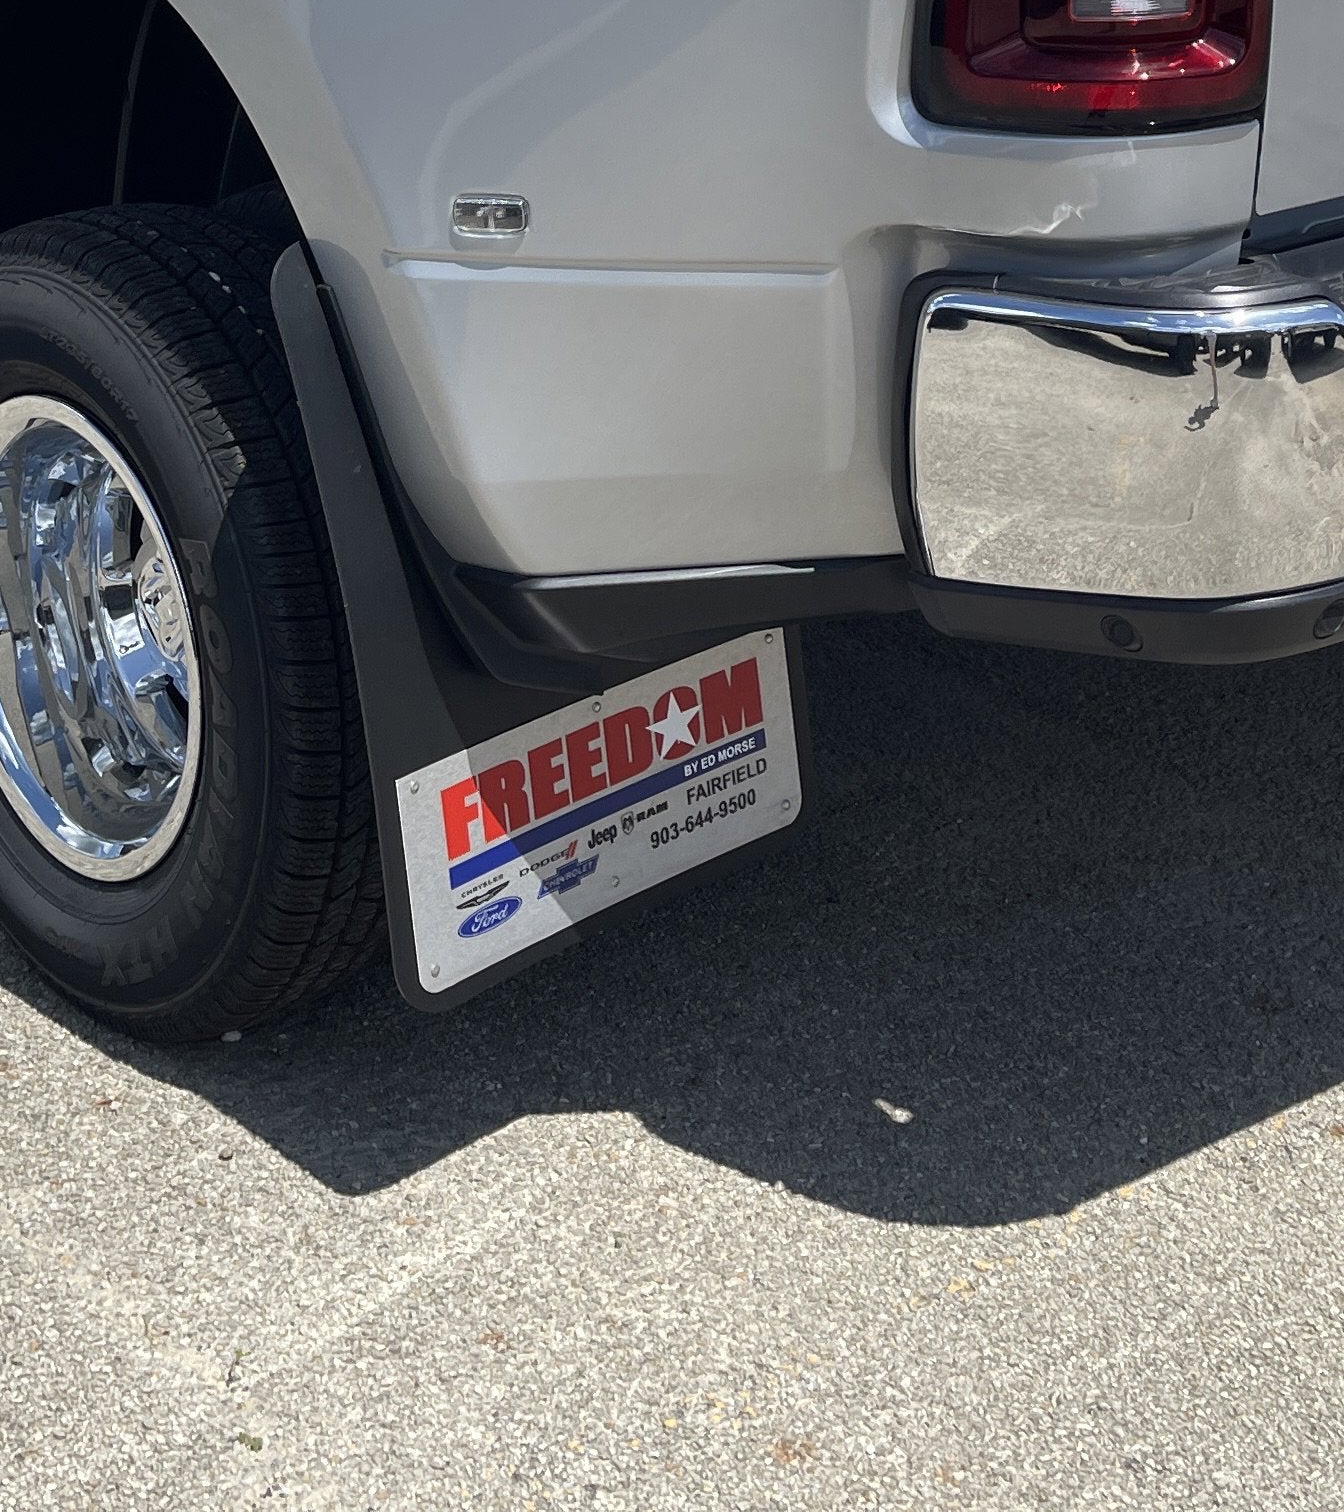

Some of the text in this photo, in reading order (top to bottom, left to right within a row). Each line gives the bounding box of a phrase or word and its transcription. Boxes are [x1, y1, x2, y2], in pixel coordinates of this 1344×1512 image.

[440, 657, 764, 862] FREEDOM
[684, 737, 757, 777] BY ED MORSE
[687, 757, 767, 805] FAIRFIELD
[636, 800, 669, 823] RAM
[650, 788, 757, 849] 903-644-9500
[588, 824, 618, 850] Jeep
[519, 847, 569, 878] DODGE
[544, 860, 595, 889] CHEVROLET
[460, 873, 504, 899] CHRYSLER
[471, 904, 509, 932] Ford
